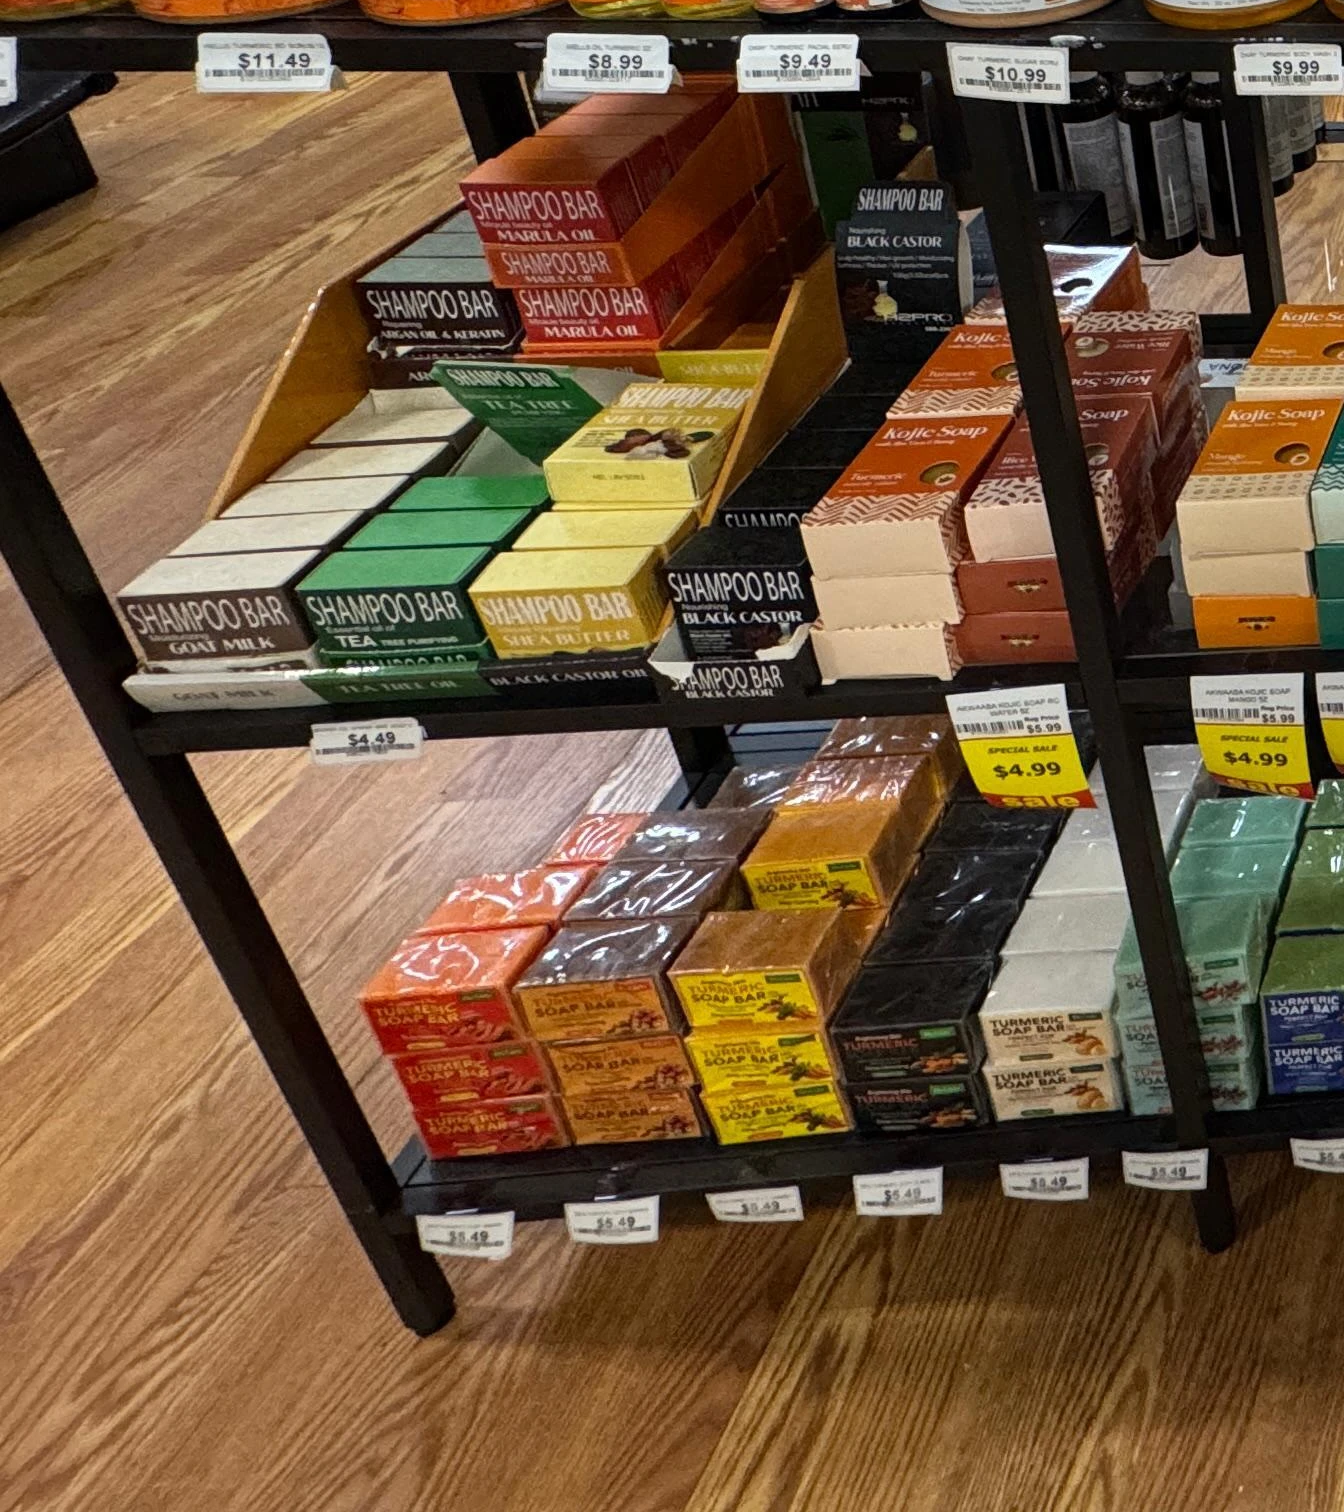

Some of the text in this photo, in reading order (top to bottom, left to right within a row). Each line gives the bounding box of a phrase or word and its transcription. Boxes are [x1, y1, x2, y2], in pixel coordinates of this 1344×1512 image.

[238, 51, 312, 71] $11.49
[588, 53, 643, 70] $8.99
[779, 51, 833, 71] $9.49
[1272, 60, 1320, 75] $9.99
[984, 64, 1047, 86] $10.99
[469, 190, 605, 220] SHAMPOO BAR
[857, 188, 944, 211] SHAMPOO BAR
[497, 230, 595, 241] MARULA OIL
[847, 236, 942, 248] BLACK CASTOR
[366, 290, 499, 319] SHAMPOO BAR
[381, 330, 419, 339] ARGAN
[420, 330, 437, 339] OIL
[454, 329, 506, 339] KERATIN
[668, 571, 804, 603] SHAMPOO BAR
[127, 595, 290, 635] SHAMPOO BAR
[681, 603, 729, 612] Nourishing
[683, 610, 803, 625] BLACK CASTOR
[168, 637, 276, 655] GOAT MILK
[335, 635, 378, 648] TEA
[490, 668, 648, 687] BLACK CASTOR OIL
[347, 732, 396, 746] $4.49
[988, 744, 1059, 755] SPECIAL SALE
[993, 762, 1062, 780] $4.99
[988, 1016, 1064, 1028] TURMERIC
[992, 1024, 1065, 1036] SOAP BAR
